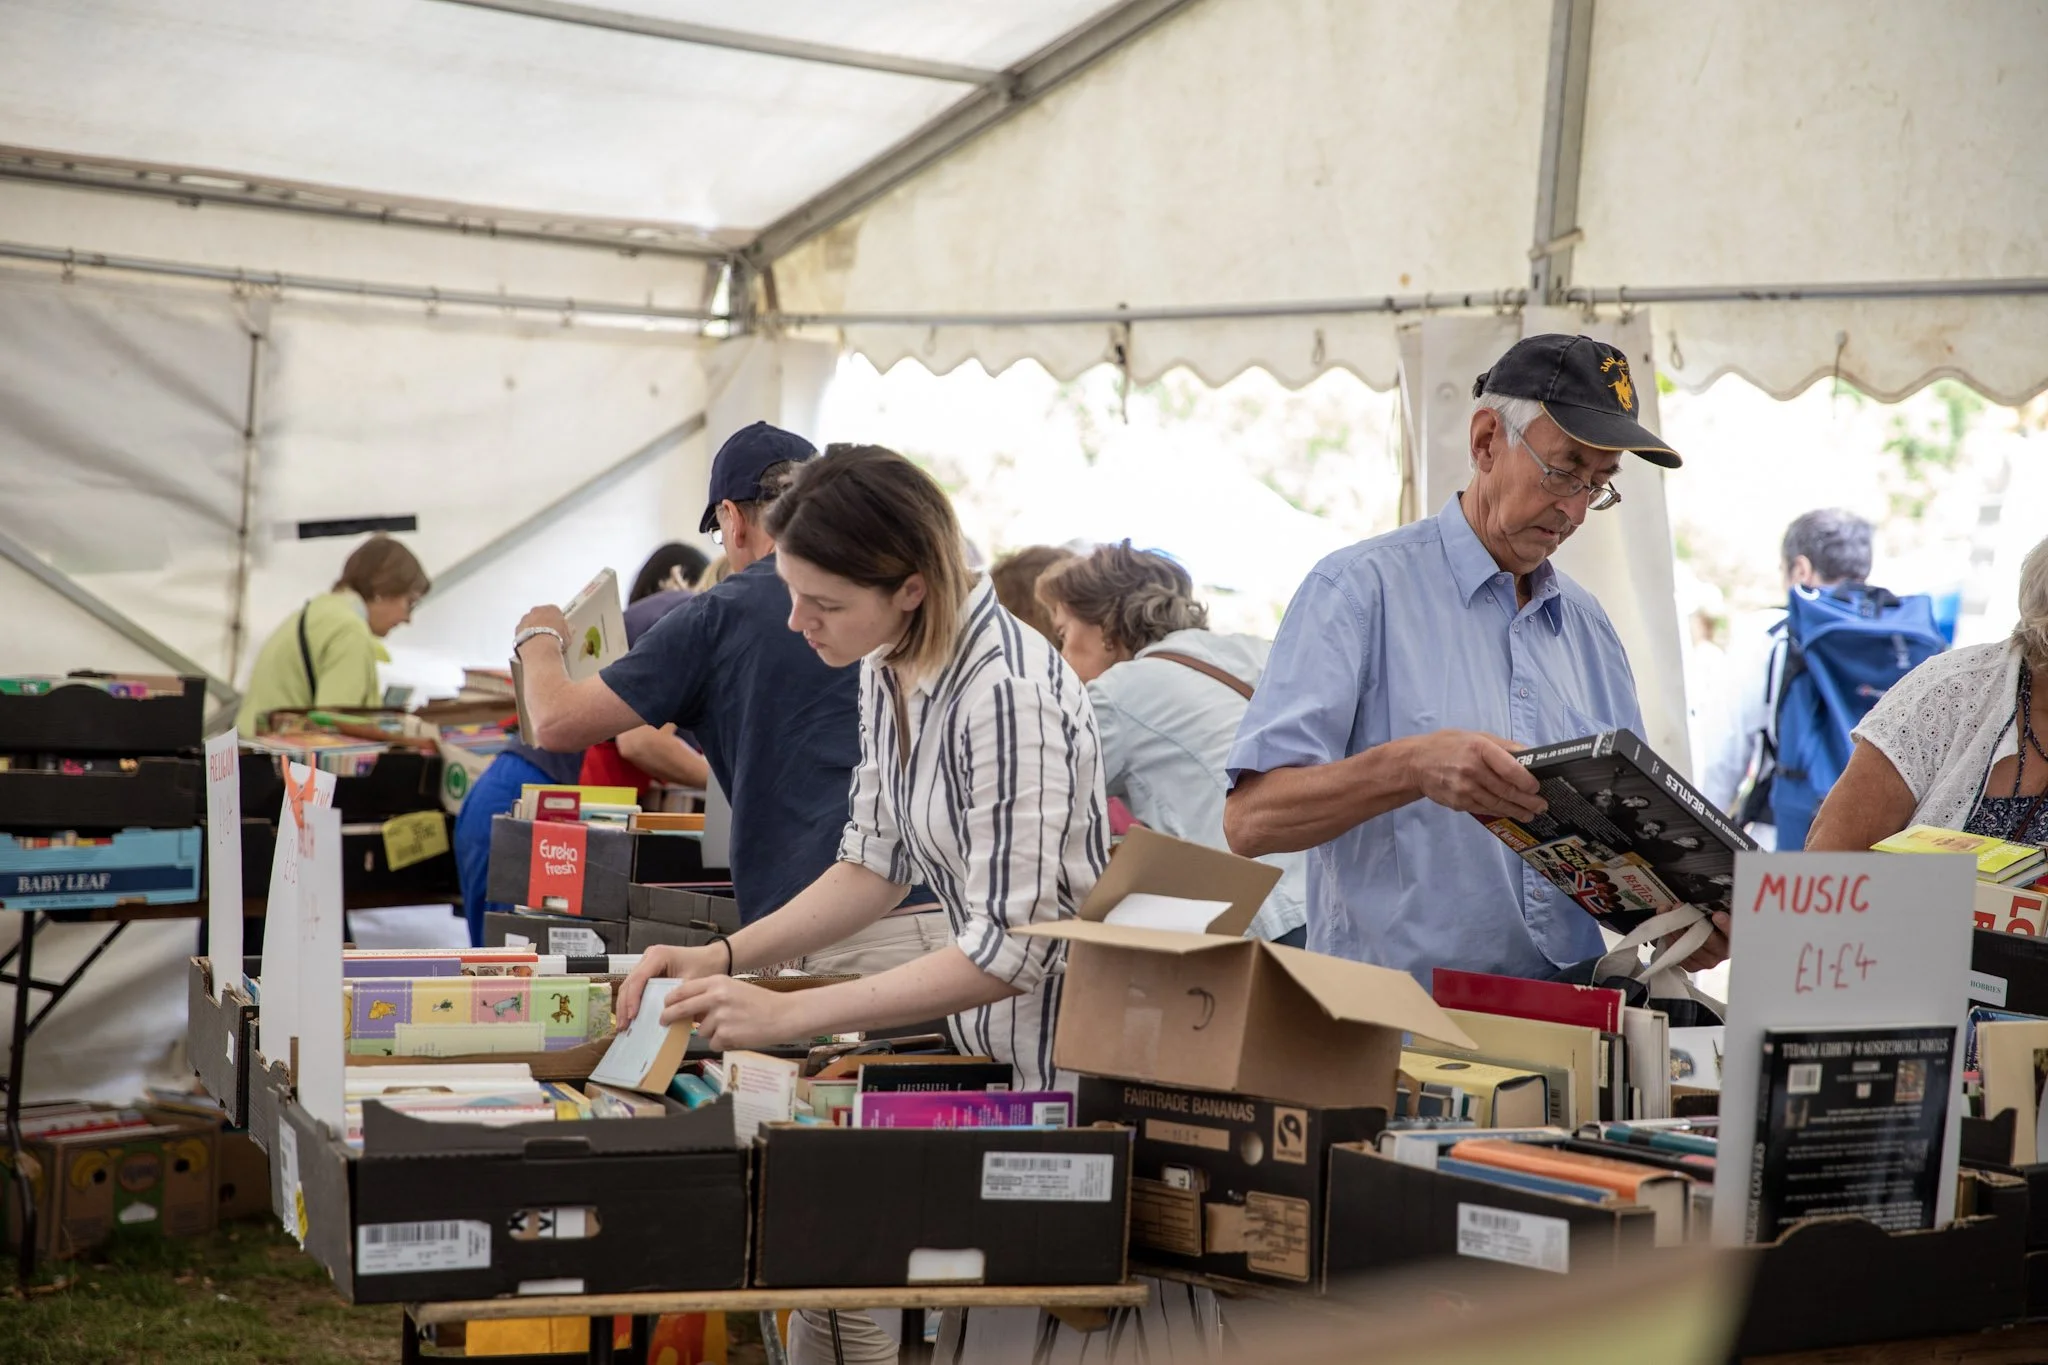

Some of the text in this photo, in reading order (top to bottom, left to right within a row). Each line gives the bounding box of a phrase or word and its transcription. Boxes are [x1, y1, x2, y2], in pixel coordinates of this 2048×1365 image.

[1535, 752, 1548, 761] THE
[1548, 750, 1557, 758] OF
[1557, 742, 1593, 757] TREASURES
[209, 746, 234, 783] RELIGION
[1665, 773, 1749, 851] TREASURES OF THE BEATLES
[539, 839, 578, 862] Eureka
[545, 861, 577, 876] fresh
[17, 873, 111, 893] BABY LEAF
[1752, 872, 1870, 914] MUSIC
[1970, 980, 2002, 993] HOBBIES
[1124, 1087, 1257, 1122] FAIRTRADE BANANAS
